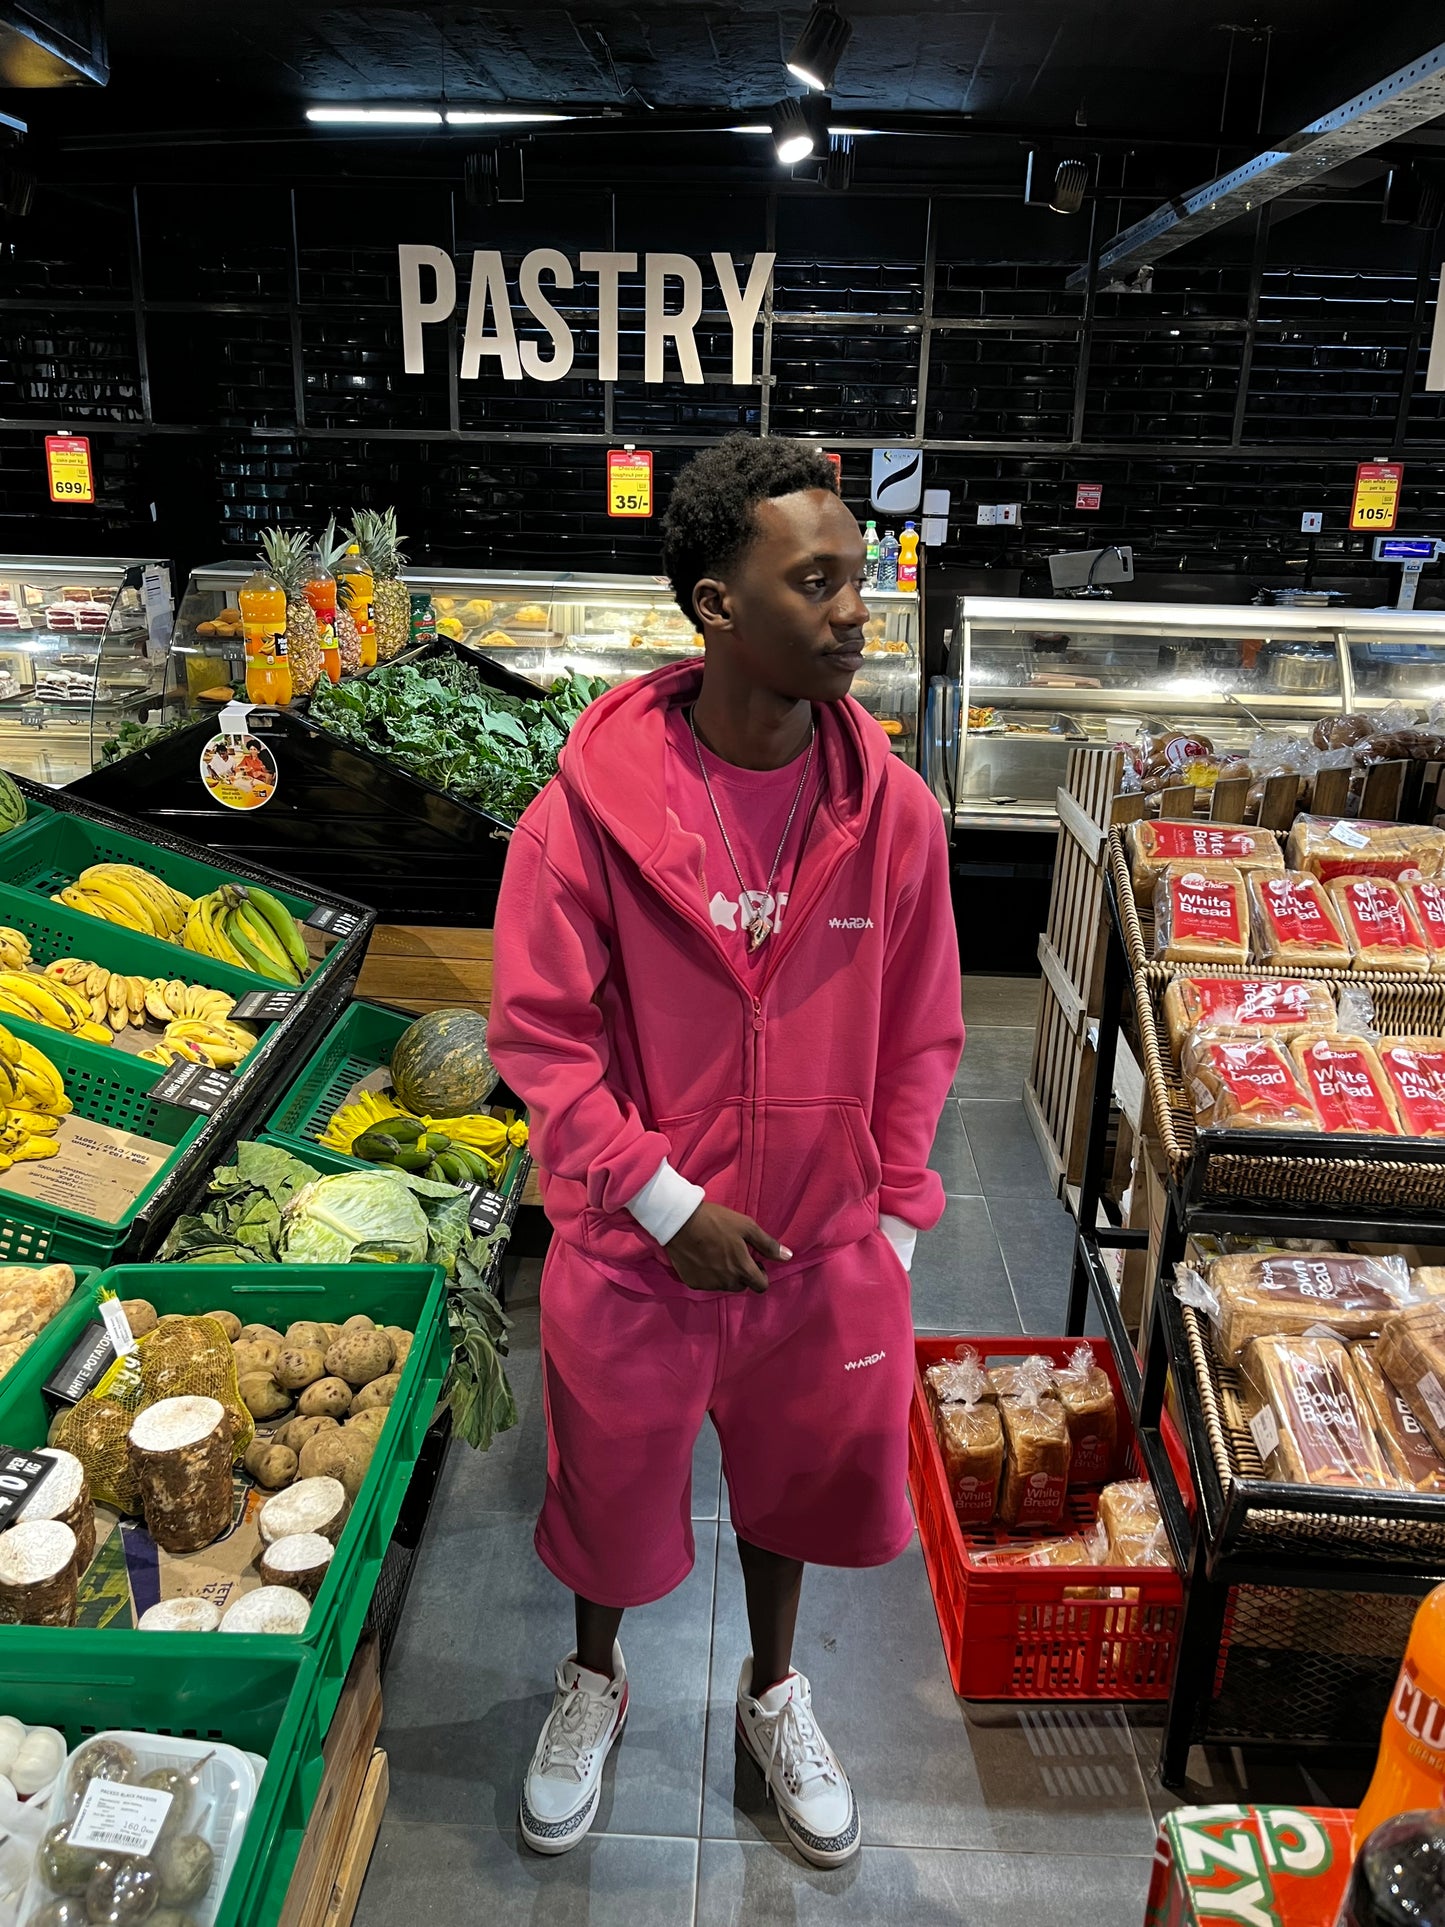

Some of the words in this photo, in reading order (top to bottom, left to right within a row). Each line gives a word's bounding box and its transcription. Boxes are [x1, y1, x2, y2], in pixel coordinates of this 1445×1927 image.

[399, 244, 776, 385] PASTRY
[55, 481, 91, 494] 699/-
[615, 495, 648, 509] 35/-
[1358, 508, 1392, 519] 105/-
[1209, 831, 1225, 855] Wite
[1178, 892, 1231, 907] White
[1269, 895, 1316, 910] Whte
[1180, 902, 1231, 917] Bread
[1273, 907, 1321, 920] Brad
[828, 917, 874, 929] WARDA
[1329, 1051, 1358, 1059] Choice
[161, 1082, 180, 1098] LONG
[176, 1063, 199, 1085] BANANA
[198, 1078, 227, 1096] 89
[479, 1198, 501, 1215] 99
[1292, 1260, 1319, 1297] Bown
[844, 1350, 886, 1371] WARDA
[66, 1369, 90, 1398] WHITE
[1294, 1386, 1352, 1409] Bown
[1300, 1403, 1358, 1430] Bead
[5, 1456, 29, 1471] PER
[22, 1462, 42, 1475] KG
[957, 1491, 992, 1501] White
[1027, 1488, 1060, 1499] White
[1023, 1497, 1060, 1507] Bread
[202, 1582, 218, 1593] 12
[1408, 1741, 1445, 1774] ORANG
